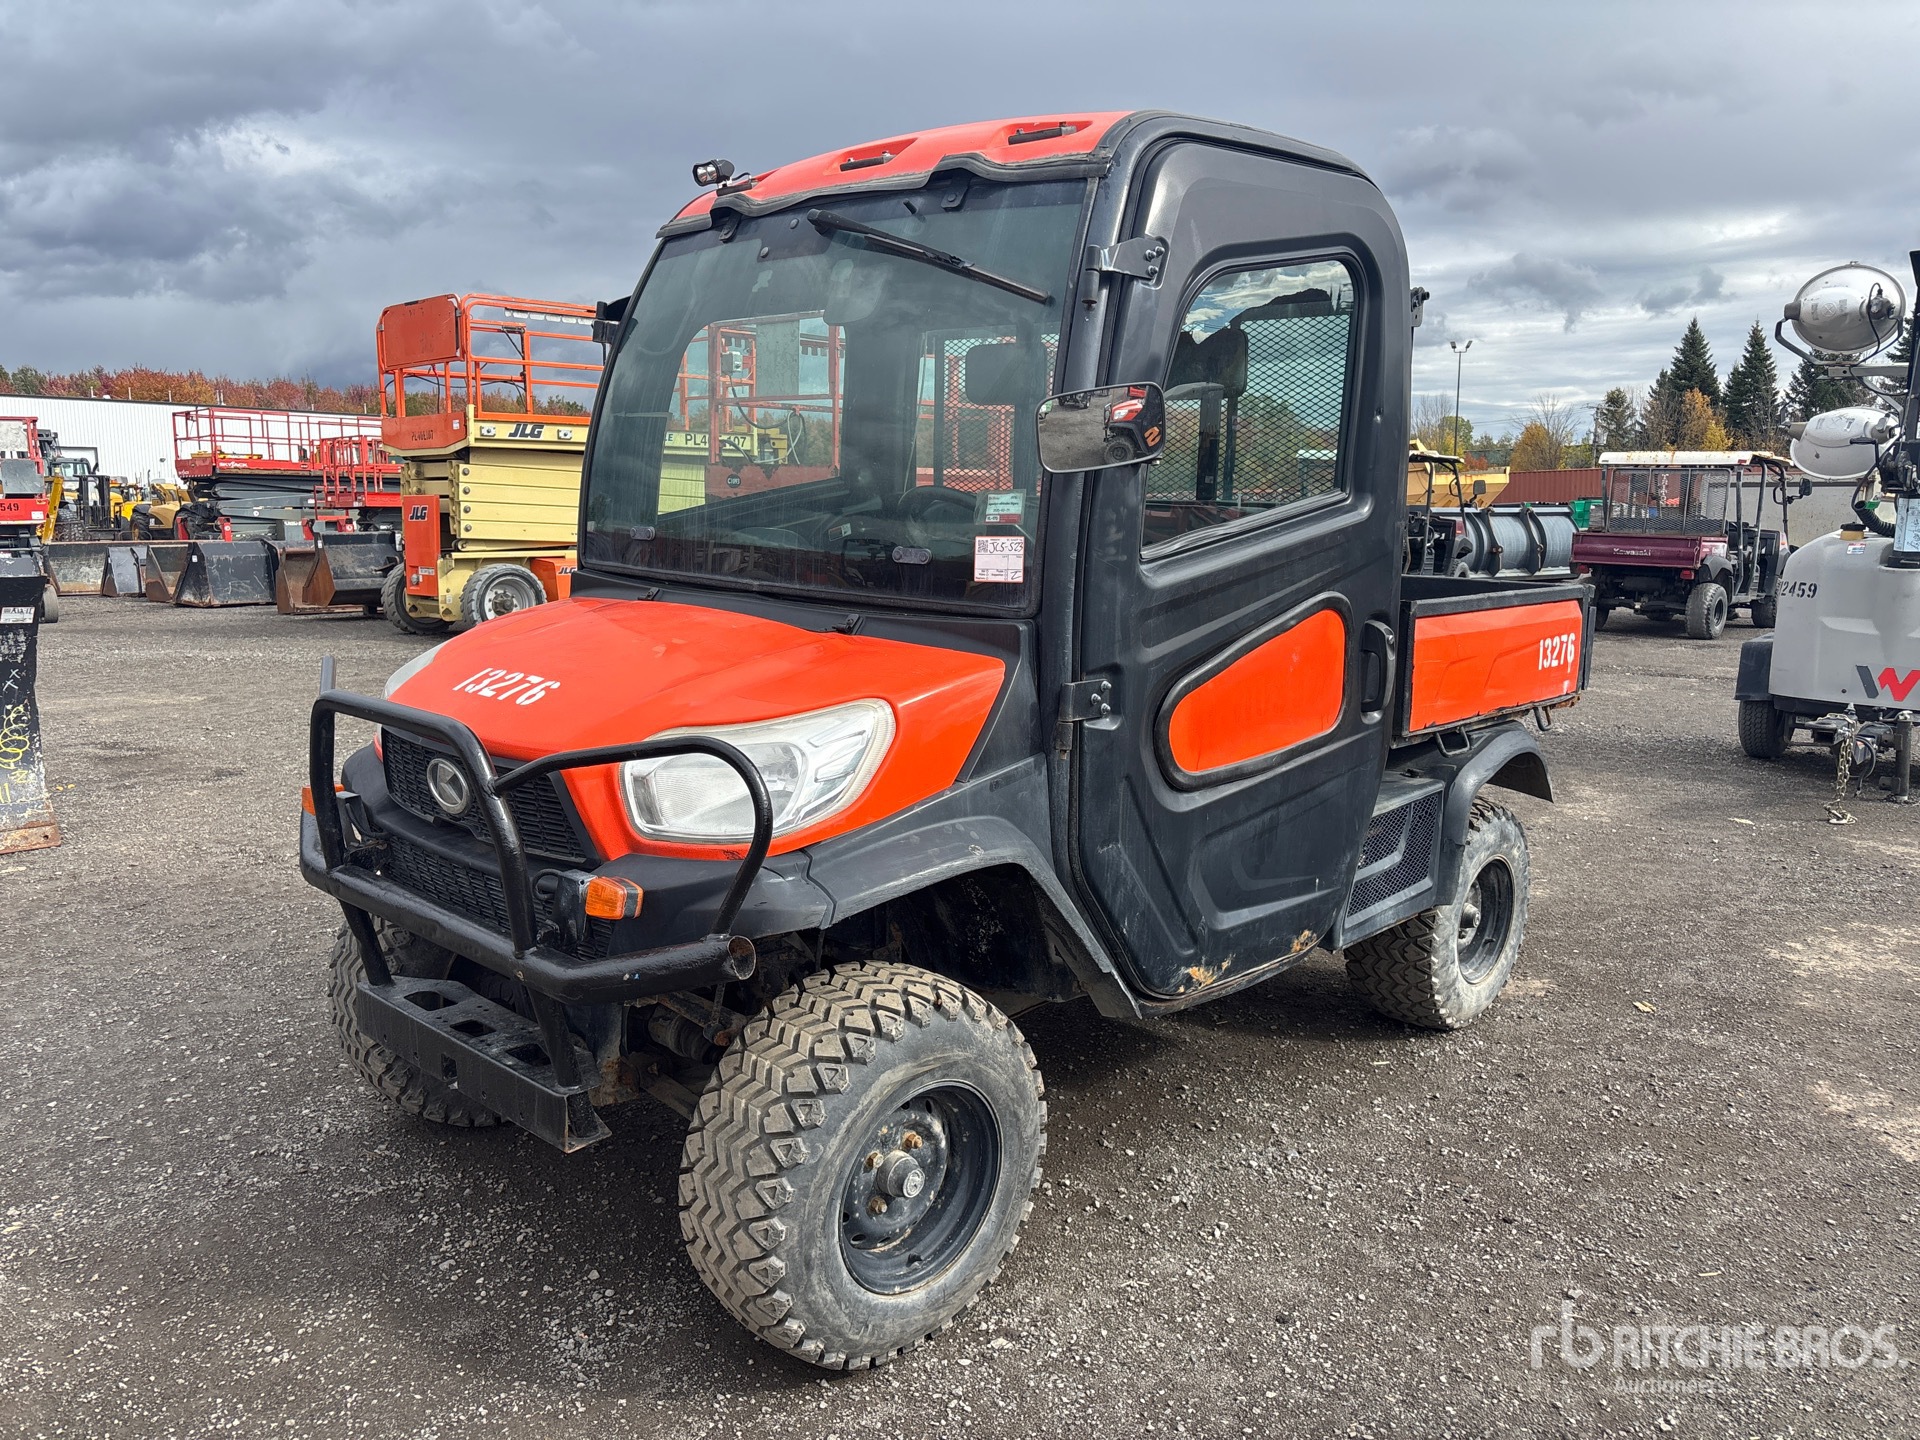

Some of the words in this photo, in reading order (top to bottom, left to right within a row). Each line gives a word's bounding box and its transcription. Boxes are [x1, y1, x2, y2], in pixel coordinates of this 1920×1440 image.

[508, 423, 544, 438] JLG
[409, 506, 428, 521] JLG
[1612, 547, 1652, 557] Kawasaki
[1538, 632, 1576, 671] 13276
[452, 667, 561, 706] 13276
